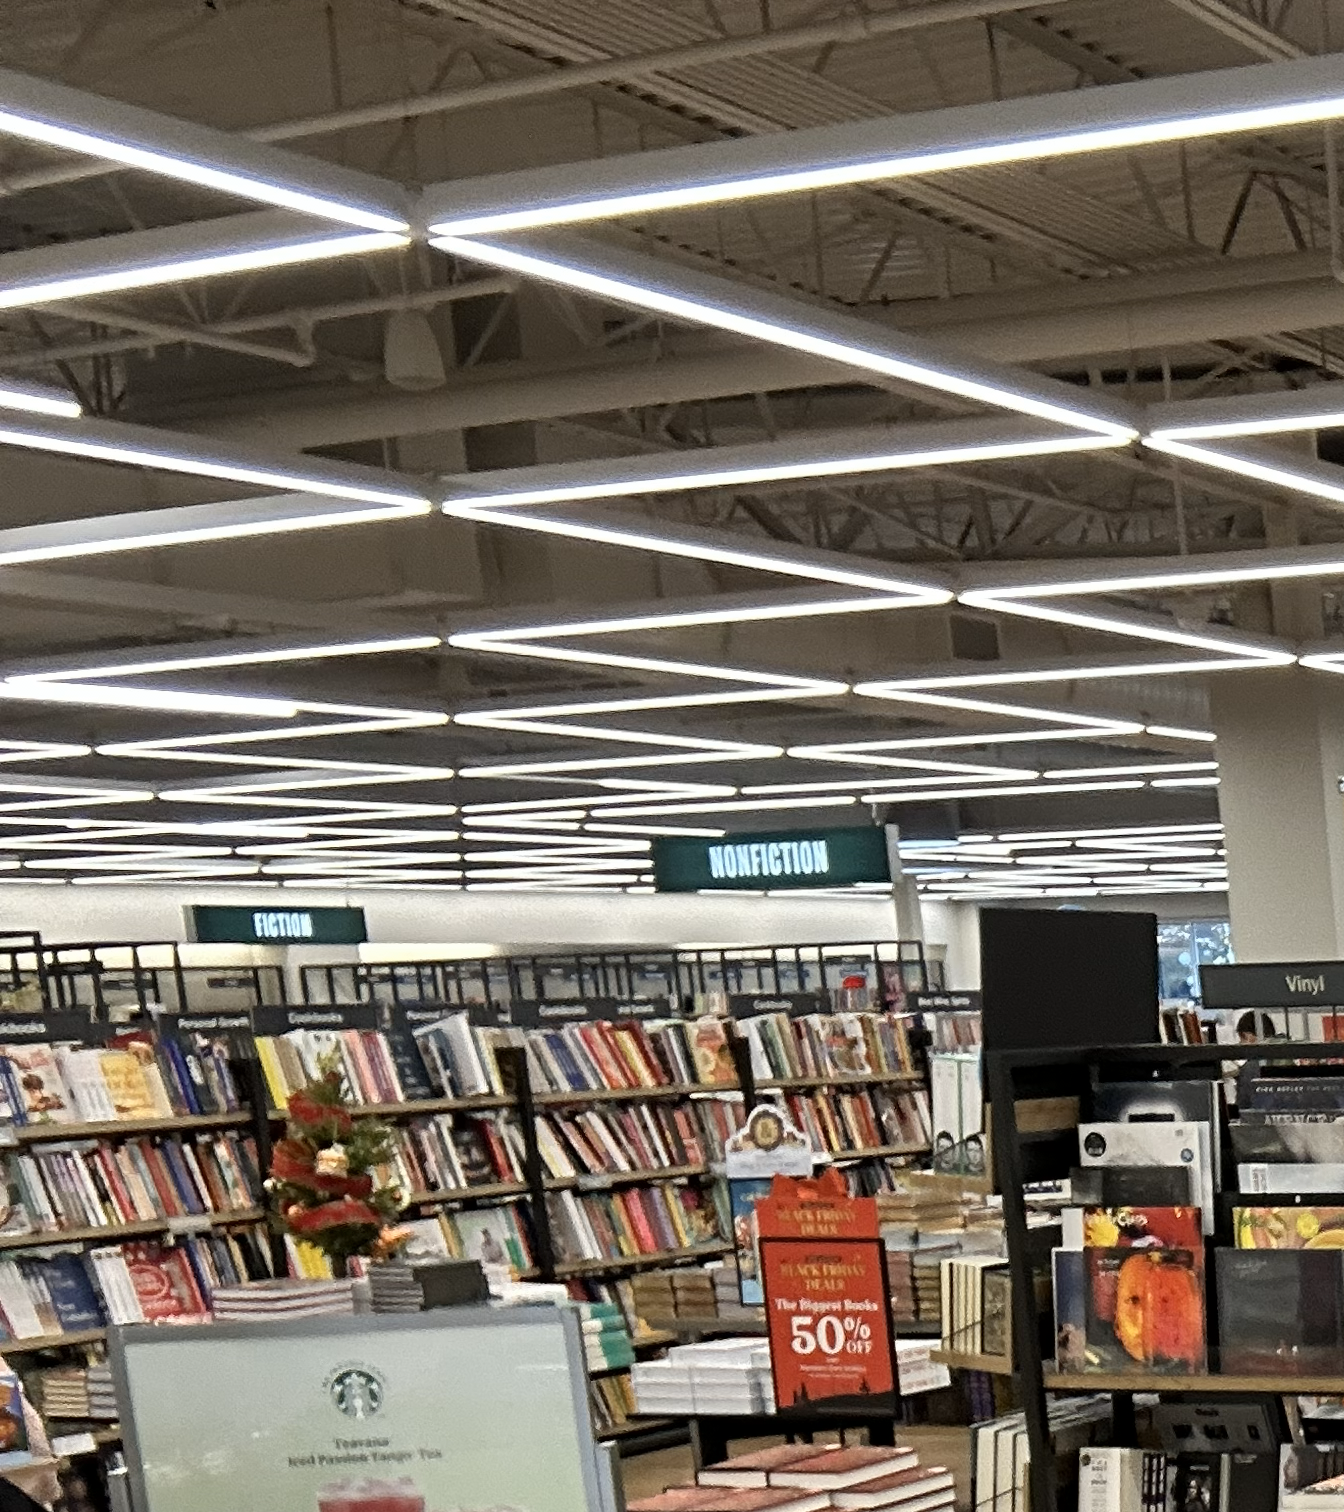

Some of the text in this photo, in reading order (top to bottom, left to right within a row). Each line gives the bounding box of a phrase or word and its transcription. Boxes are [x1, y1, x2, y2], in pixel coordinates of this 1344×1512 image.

[708, 839, 830, 879] NONFICTION
[252, 912, 312, 938] FICTION
[1286, 975, 1325, 995] Vinyl
[774, 1298, 878, 1316] The Biggest Books
[791, 1315, 871, 1355] 50%
[846, 1340, 872, 1354] OFF
